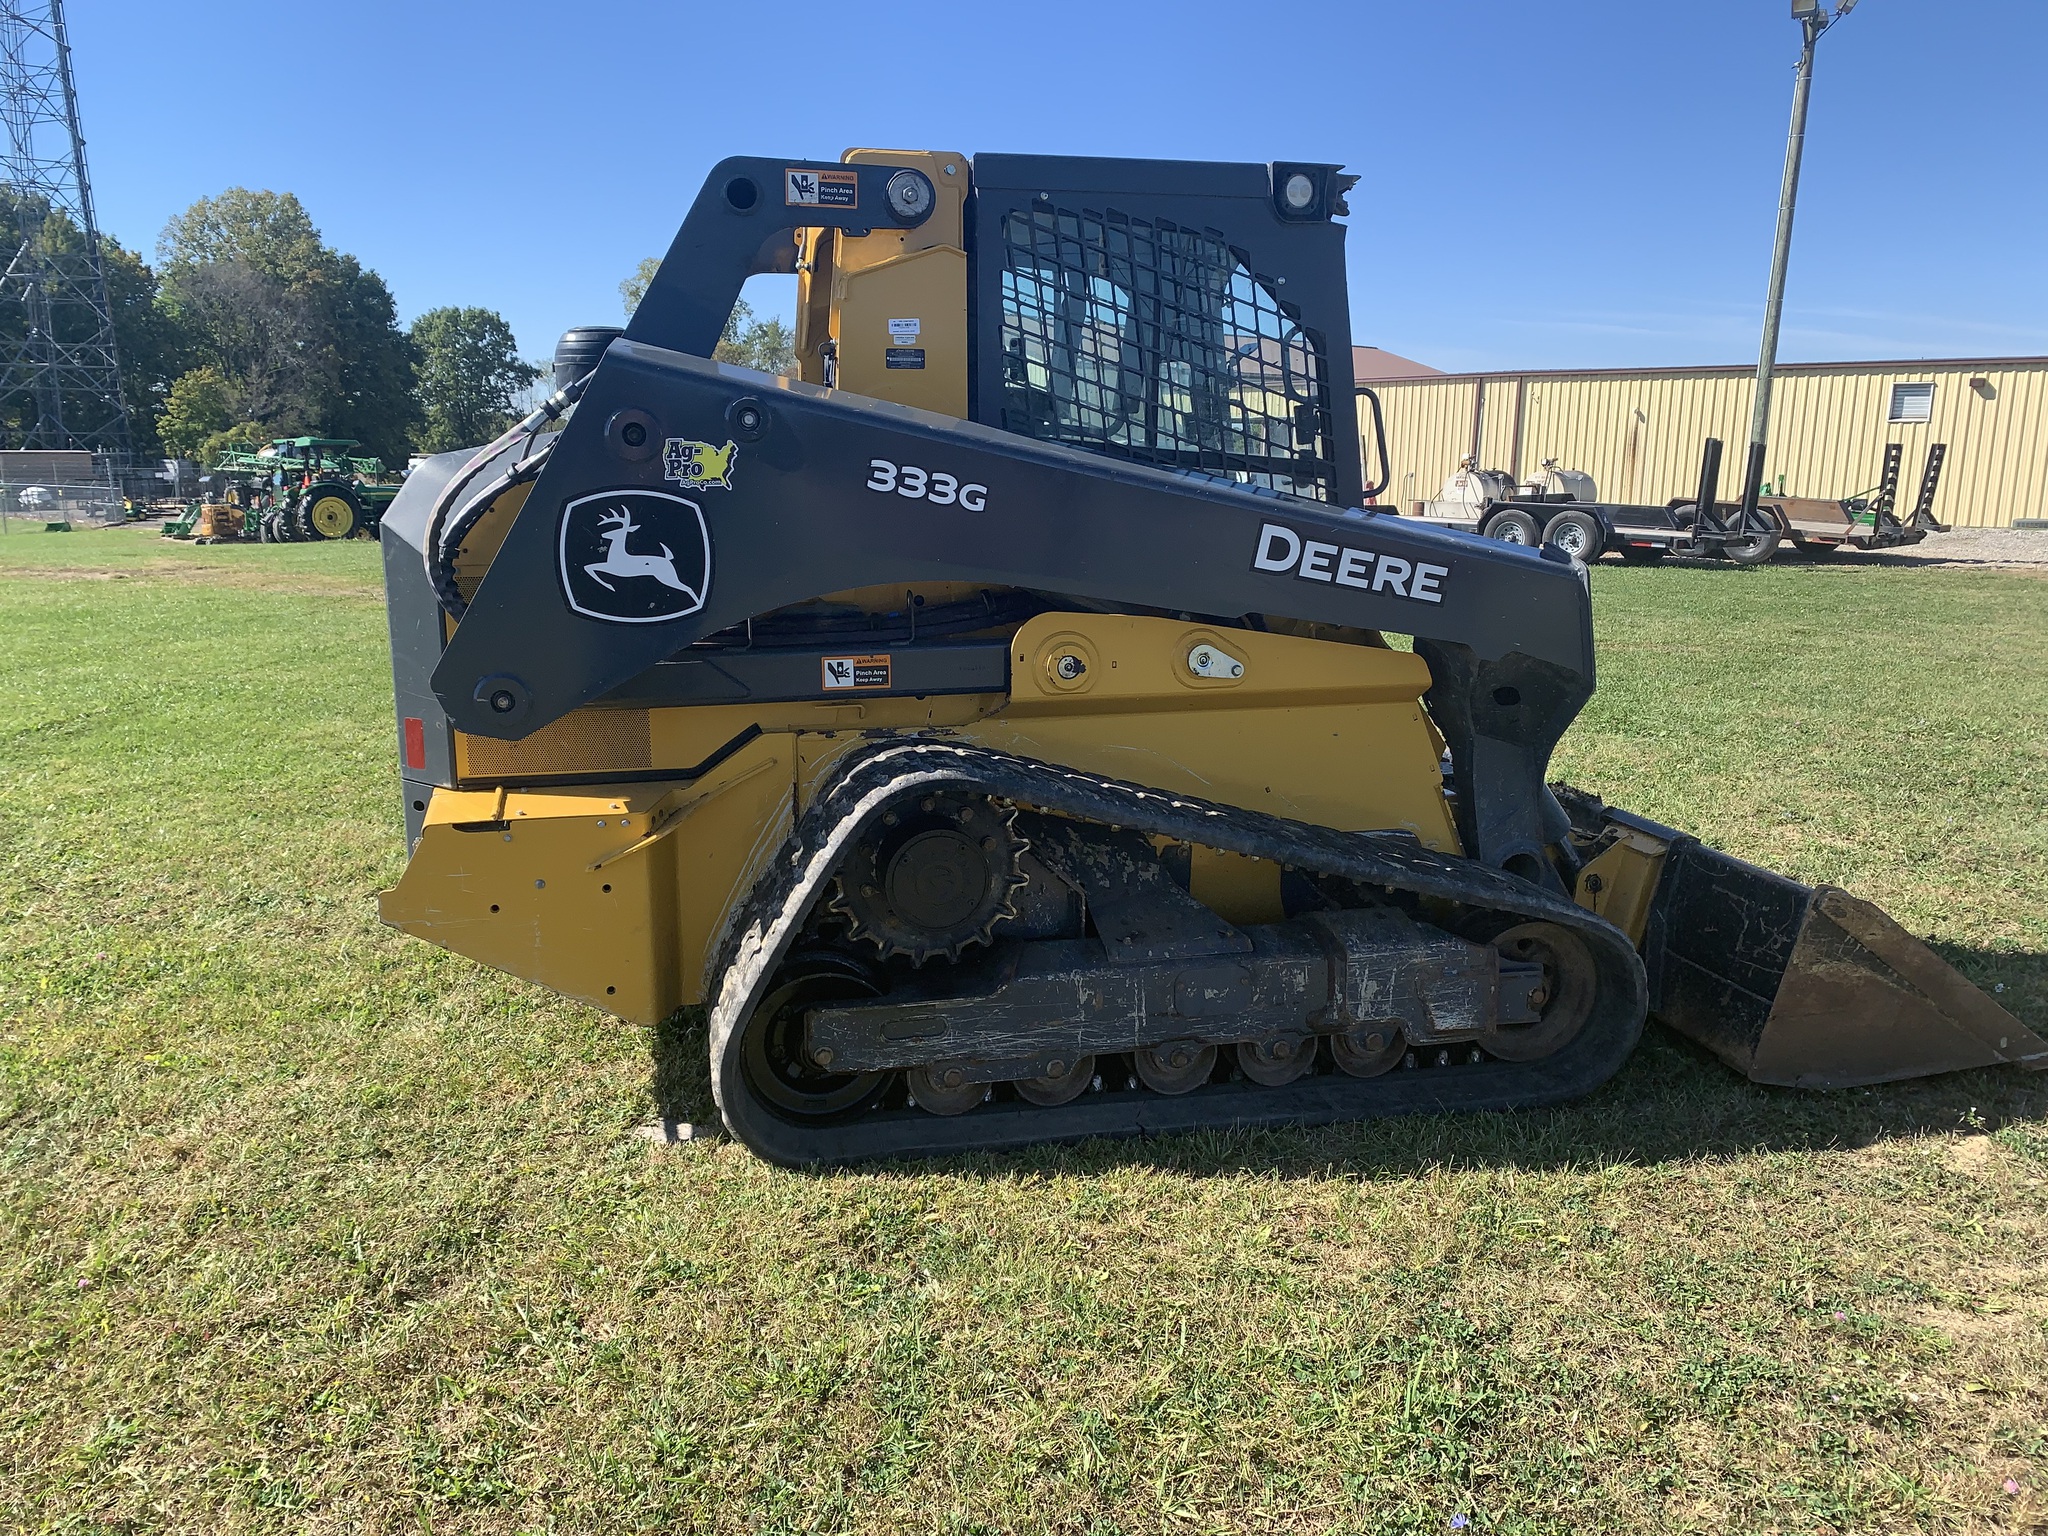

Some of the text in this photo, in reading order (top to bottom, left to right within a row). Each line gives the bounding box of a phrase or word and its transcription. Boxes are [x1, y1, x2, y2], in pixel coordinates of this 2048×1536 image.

[820, 186, 838, 194] Pinch
[666, 441, 702, 463] Ag-
[666, 460, 703, 477] Pro
[866, 459, 988, 512] 333G
[1253, 523, 1449, 603] DEERE
